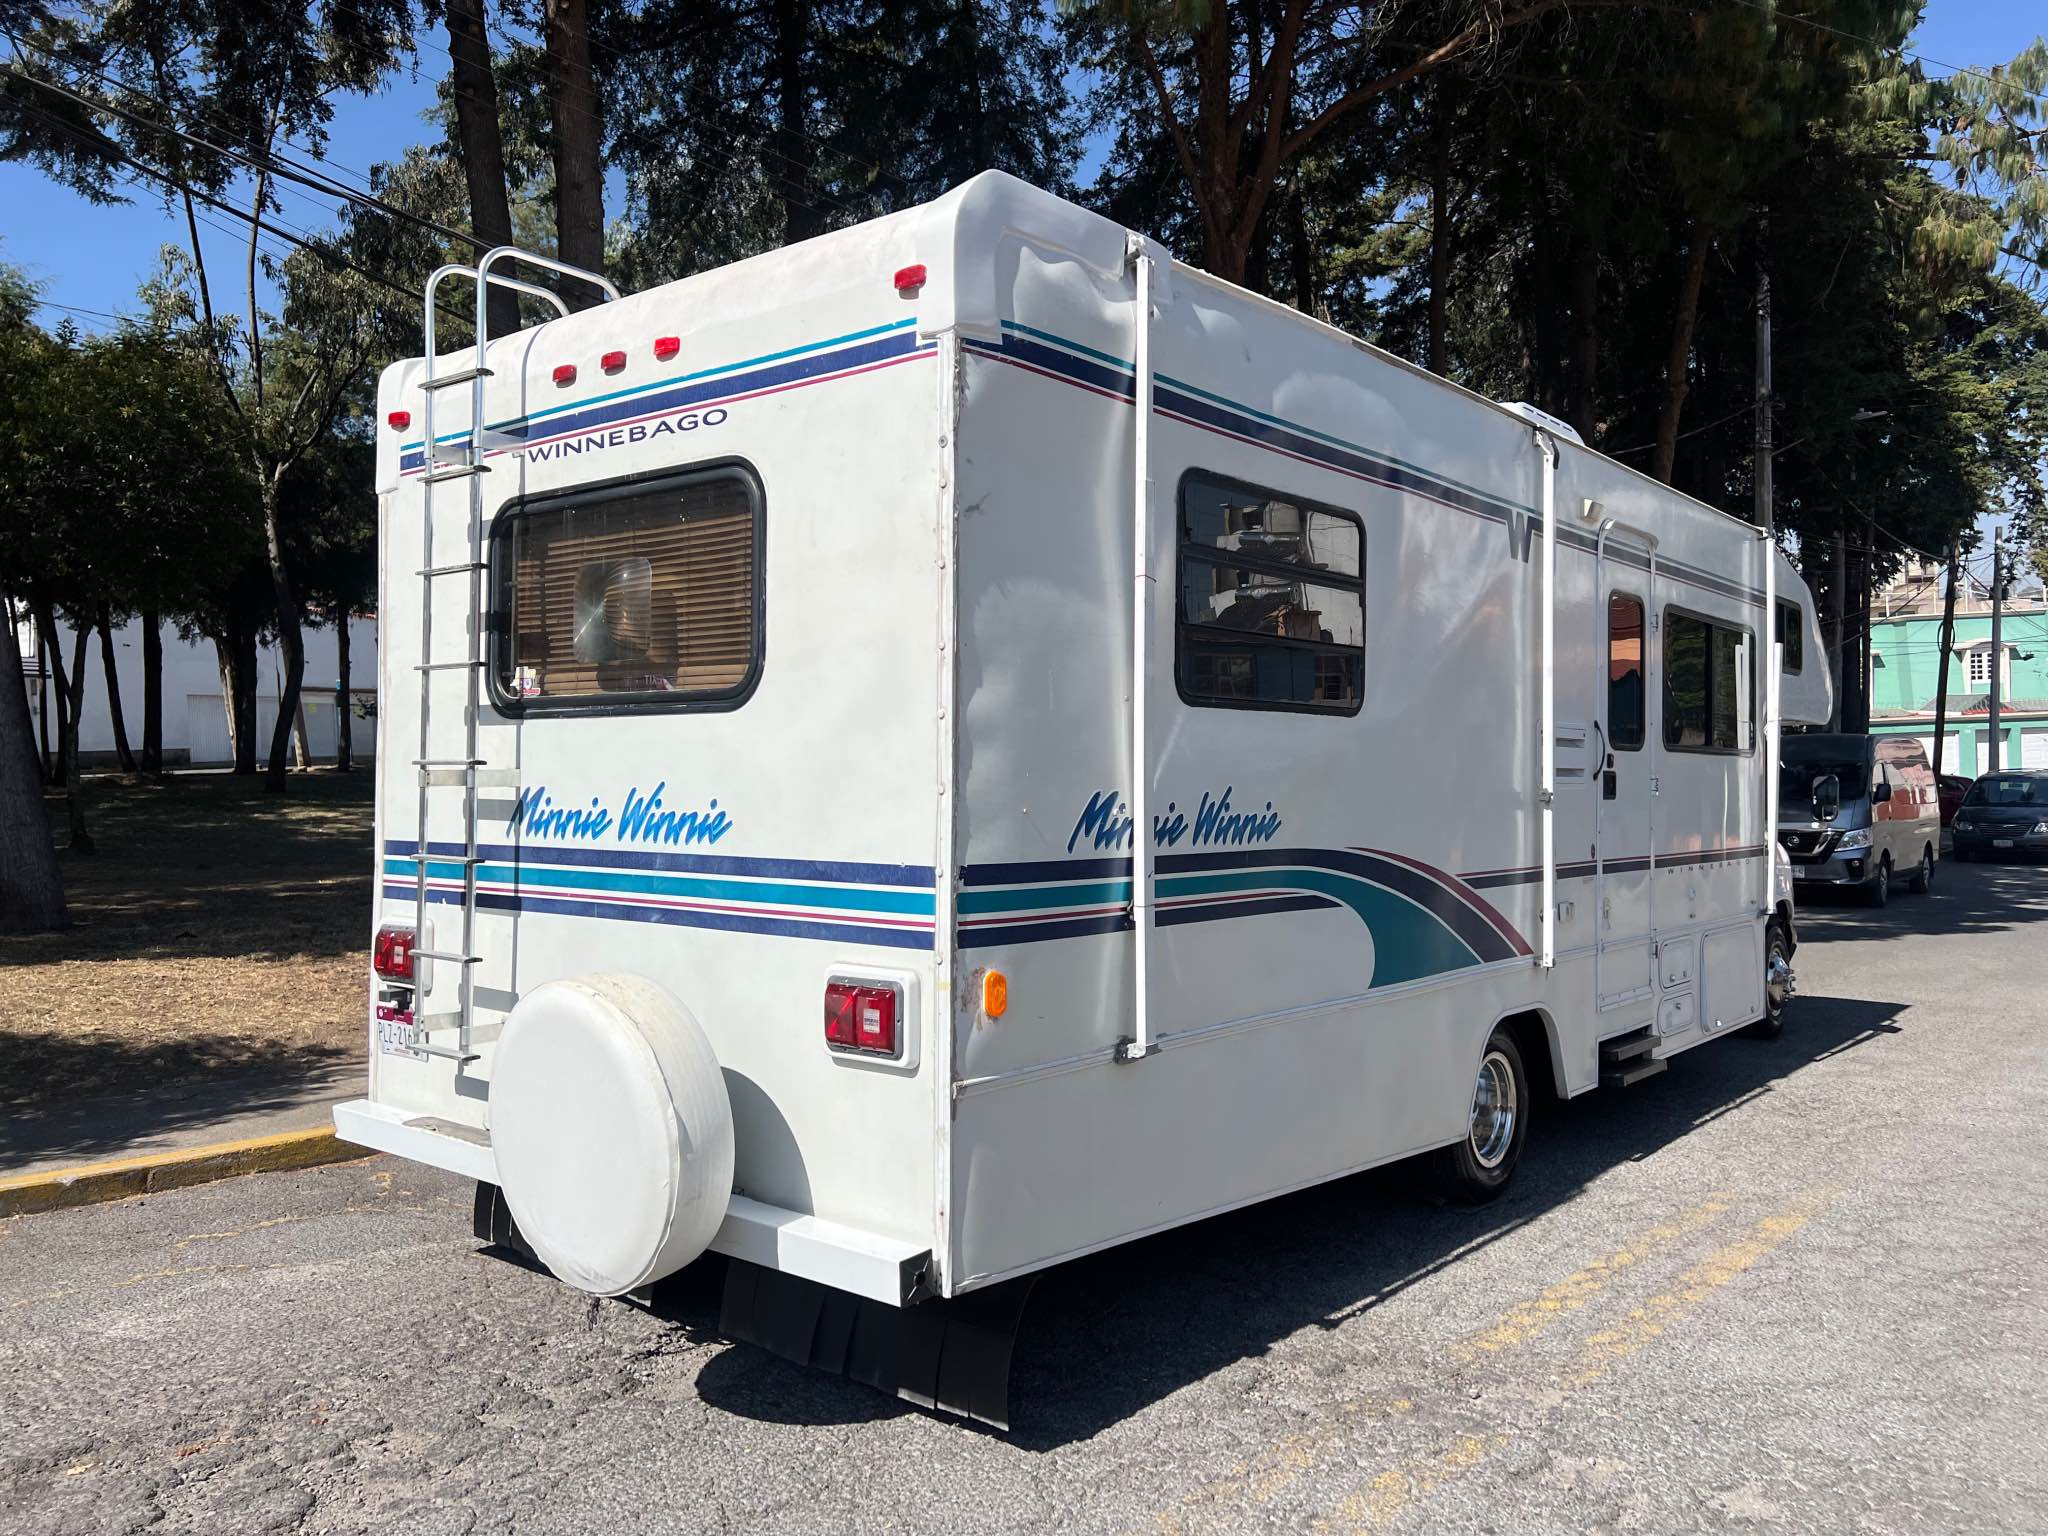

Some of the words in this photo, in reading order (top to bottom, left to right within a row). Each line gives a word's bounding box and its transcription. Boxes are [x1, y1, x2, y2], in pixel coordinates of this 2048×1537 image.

[528, 408, 728, 463] WINNEBAGO
[506, 786, 613, 840] Minnie
[617, 781, 734, 845] Winnie
[1192, 785, 1282, 847] Winnie
[1668, 858, 1750, 875] WINNEBAGO
